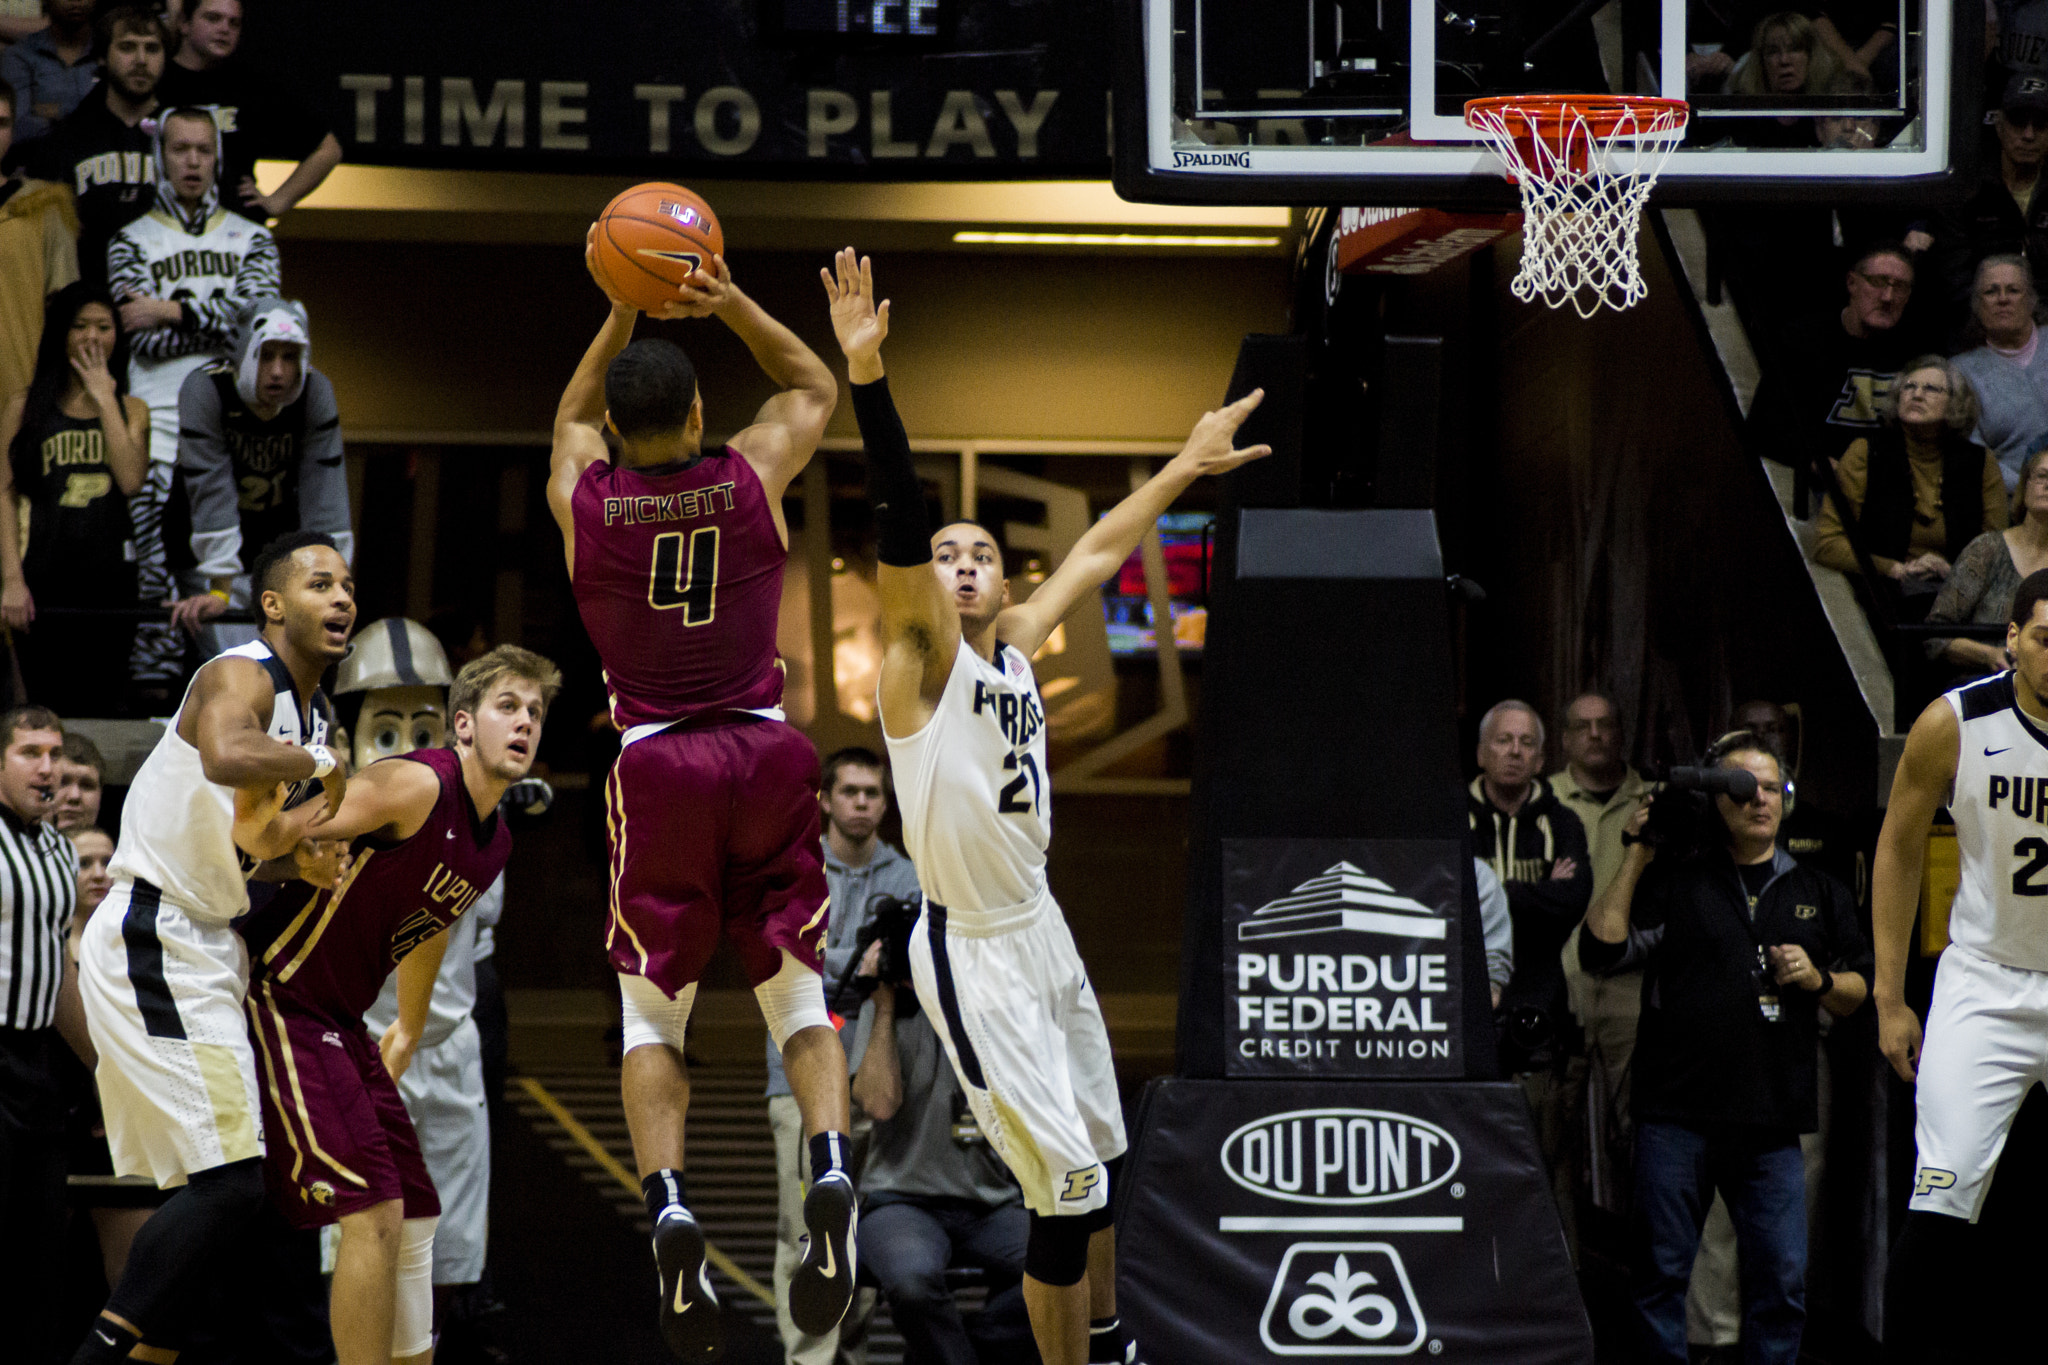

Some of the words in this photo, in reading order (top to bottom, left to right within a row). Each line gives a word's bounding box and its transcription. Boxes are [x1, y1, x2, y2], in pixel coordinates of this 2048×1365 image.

[339, 74, 590, 151] TIME
[633, 85, 762, 156] TO
[805, 89, 1060, 158] PLAY
[1172, 151, 1250, 168] SPALDING
[603, 481, 736, 527] PICKETT
[648, 526, 721, 628] 4
[1237, 953, 1448, 992] PURDUE
[1237, 996, 1448, 1032] FEDERAL
[1239, 1038, 1341, 1058] CREDIT
[1354, 1038, 1450, 1059] UNION
[1060, 1163, 1100, 1202] P
[1915, 1166, 1958, 1196] P
